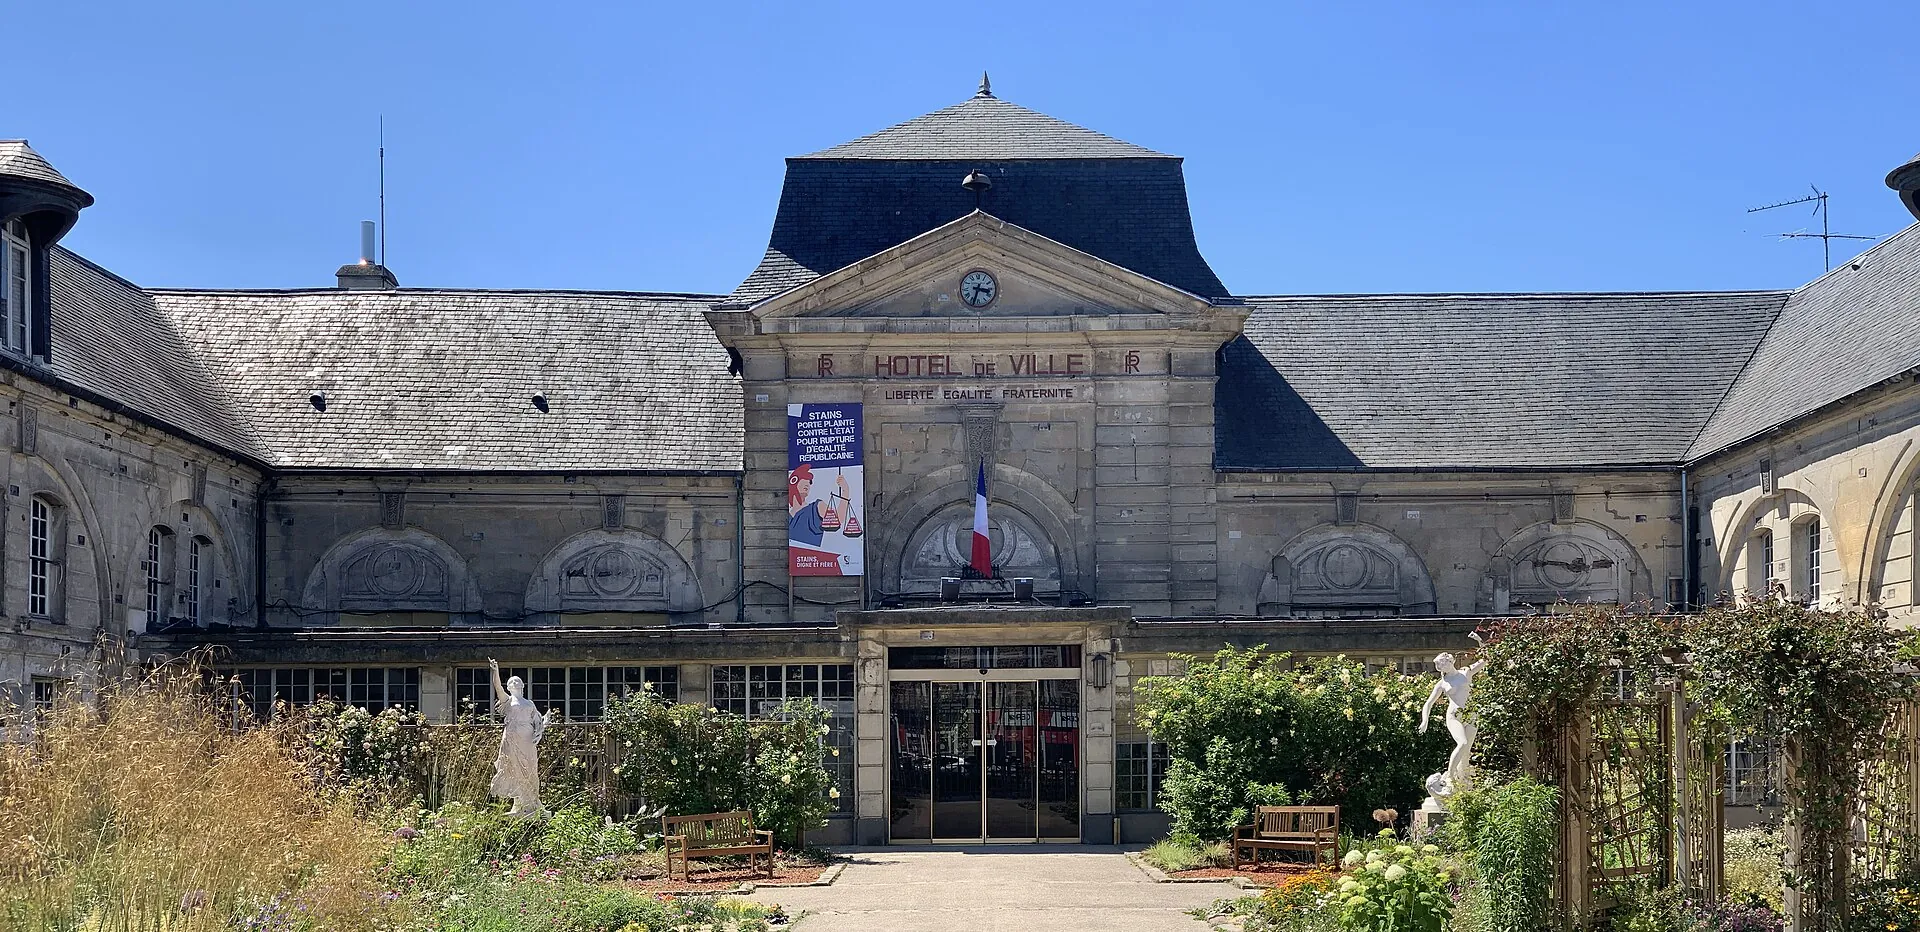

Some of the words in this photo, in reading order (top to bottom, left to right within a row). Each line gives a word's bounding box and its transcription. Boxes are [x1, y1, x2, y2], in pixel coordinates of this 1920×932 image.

[875, 355, 962, 377] HOTEL
[974, 362, 995, 376] DE
[1009, 354, 1084, 375] VILLE
[885, 390, 933, 400] LIBERTE
[943, 389, 992, 399] EGALITE
[1002, 388, 1073, 399] FRATERNITE
[809, 410, 842, 420] STAINS
[797, 421, 822, 429] PORTE
[824, 419, 855, 427] PLAINTE
[797, 429, 829, 437] CONTRE
[820, 435, 855, 444] RUPTURE
